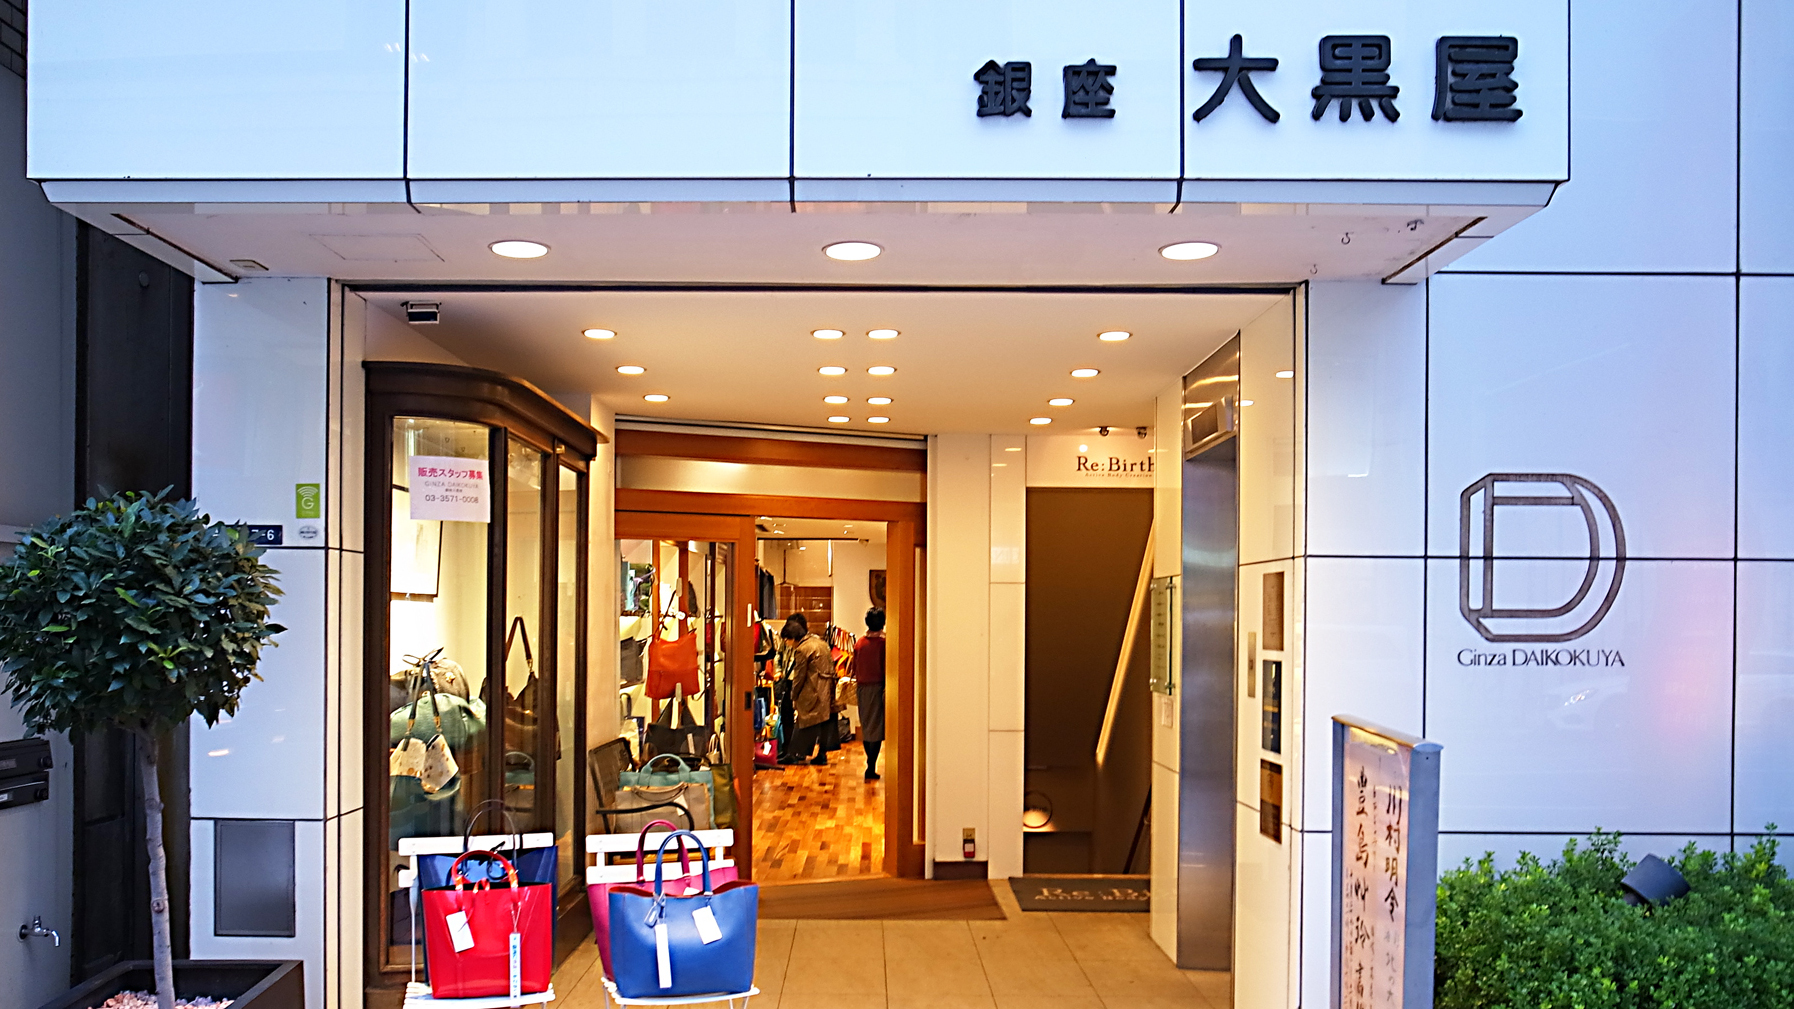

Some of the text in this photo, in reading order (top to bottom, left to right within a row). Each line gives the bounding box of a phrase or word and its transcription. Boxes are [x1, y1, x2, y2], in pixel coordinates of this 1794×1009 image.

[973, 33, 1524, 123] 銀座 大黒屋
[417, 466, 484, 480] 販売スタッフ募集
[424, 480, 446, 488] GINZA
[1457, 648, 1626, 668] Ginza DAIKOKUYA
